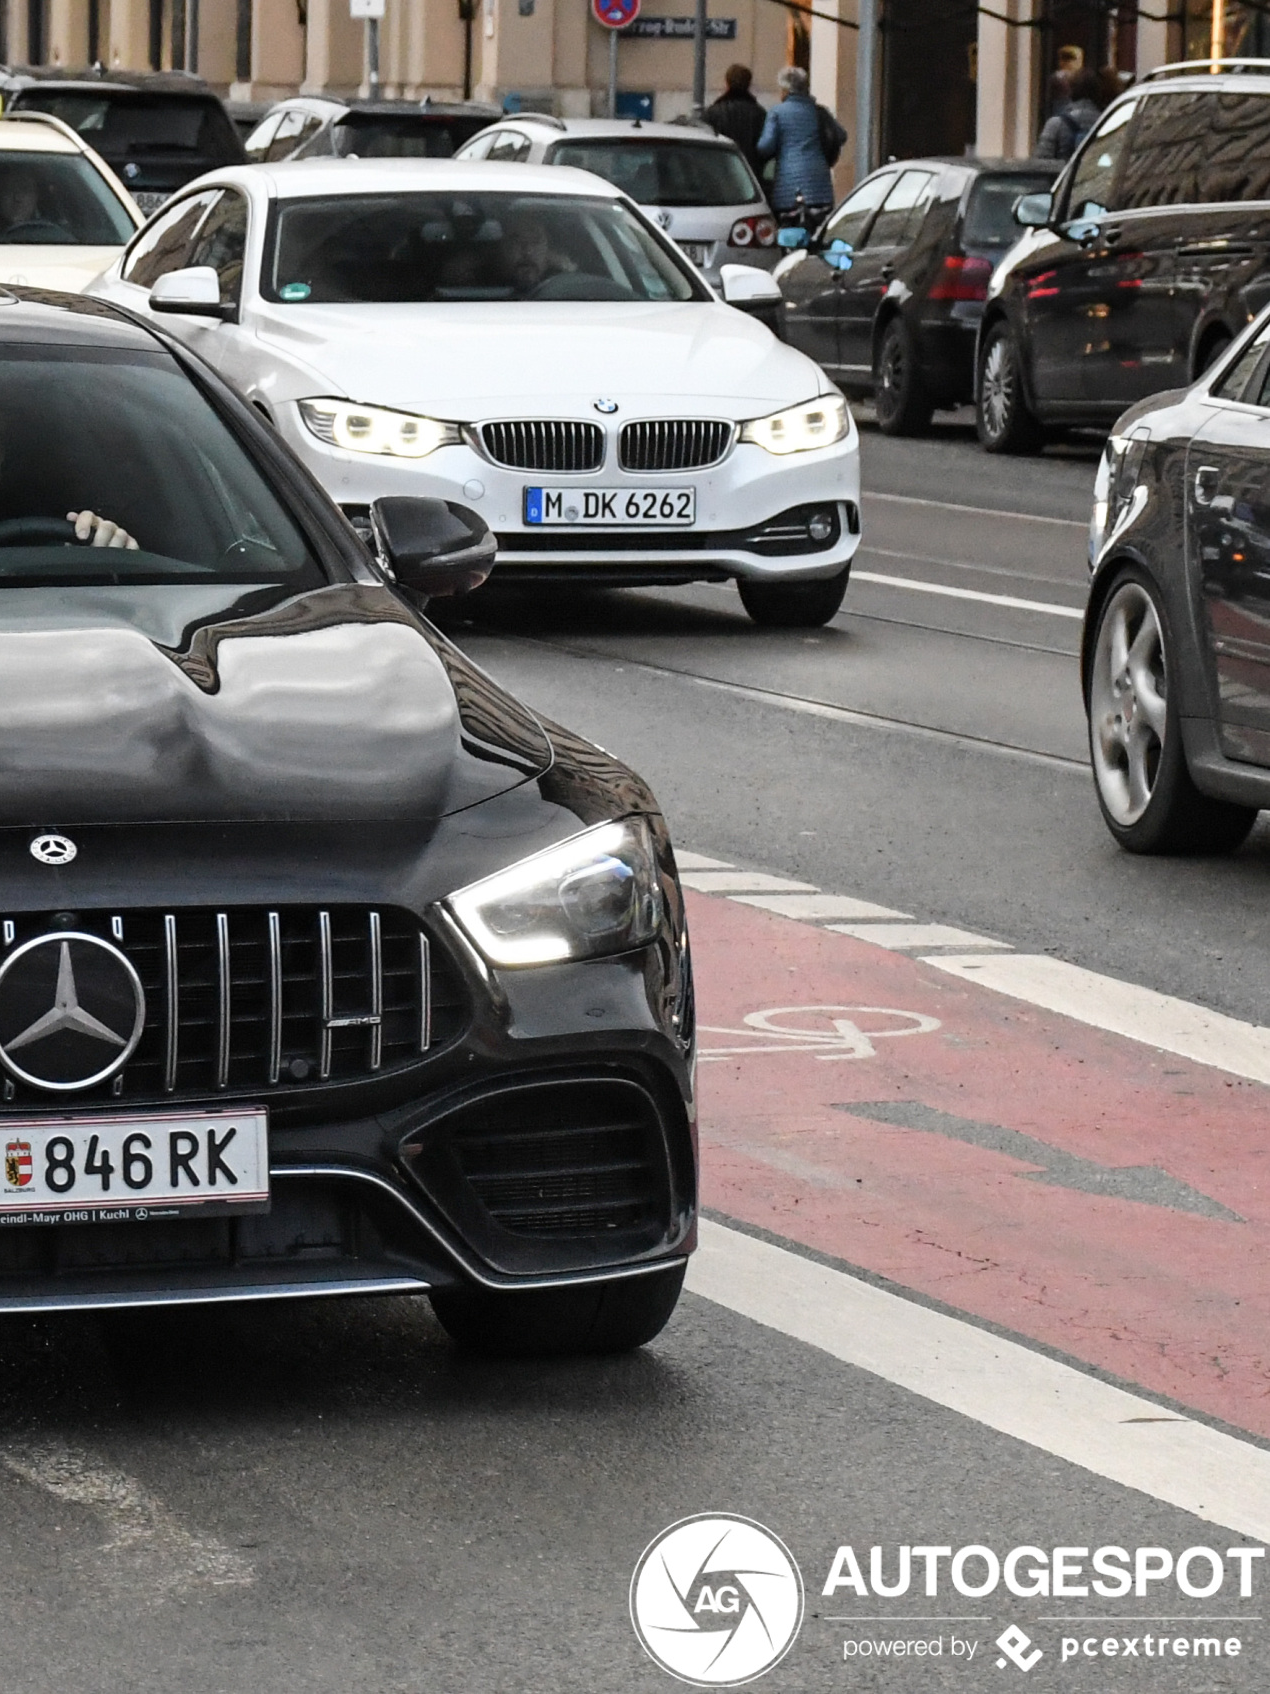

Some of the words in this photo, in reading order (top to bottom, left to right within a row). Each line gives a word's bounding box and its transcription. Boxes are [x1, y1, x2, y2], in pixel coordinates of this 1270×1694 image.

[545, 492, 562, 518] M
[583, 492, 617, 518] DK
[625, 493, 691, 519] 6262
[63, 1210, 89, 1222] OHG
[99, 1209, 130, 1220] Kuchl
